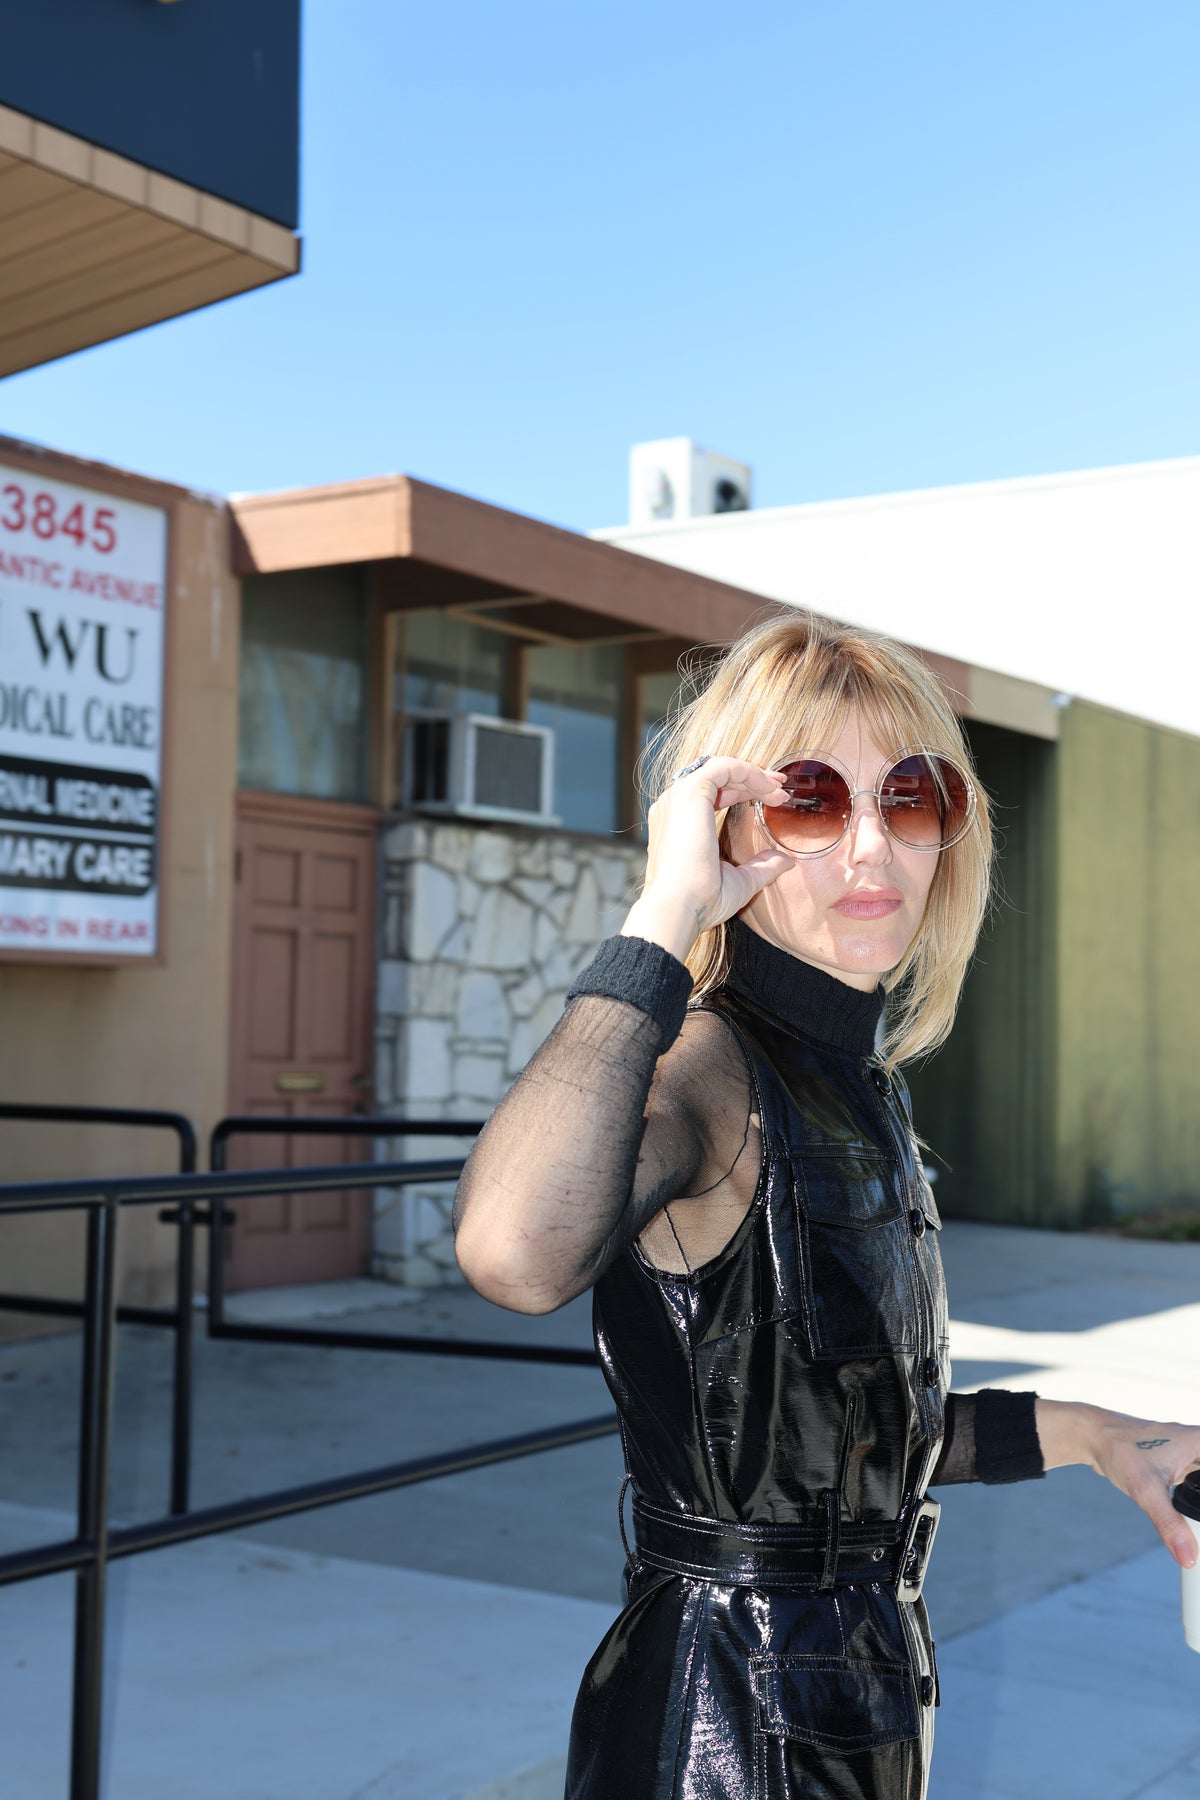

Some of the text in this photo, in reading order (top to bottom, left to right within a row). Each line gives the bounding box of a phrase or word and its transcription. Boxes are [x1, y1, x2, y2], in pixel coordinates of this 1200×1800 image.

[0, 484, 117, 555] 3845
[69, 567, 162, 610] AVENUE
[26, 607, 139, 685] WU
[84, 694, 154, 750] CARE
[55, 776, 153, 828] MEDICINE
[74, 842, 152, 888] CARE
[56, 917, 79, 937] IN
[87, 917, 149, 941] REAR
